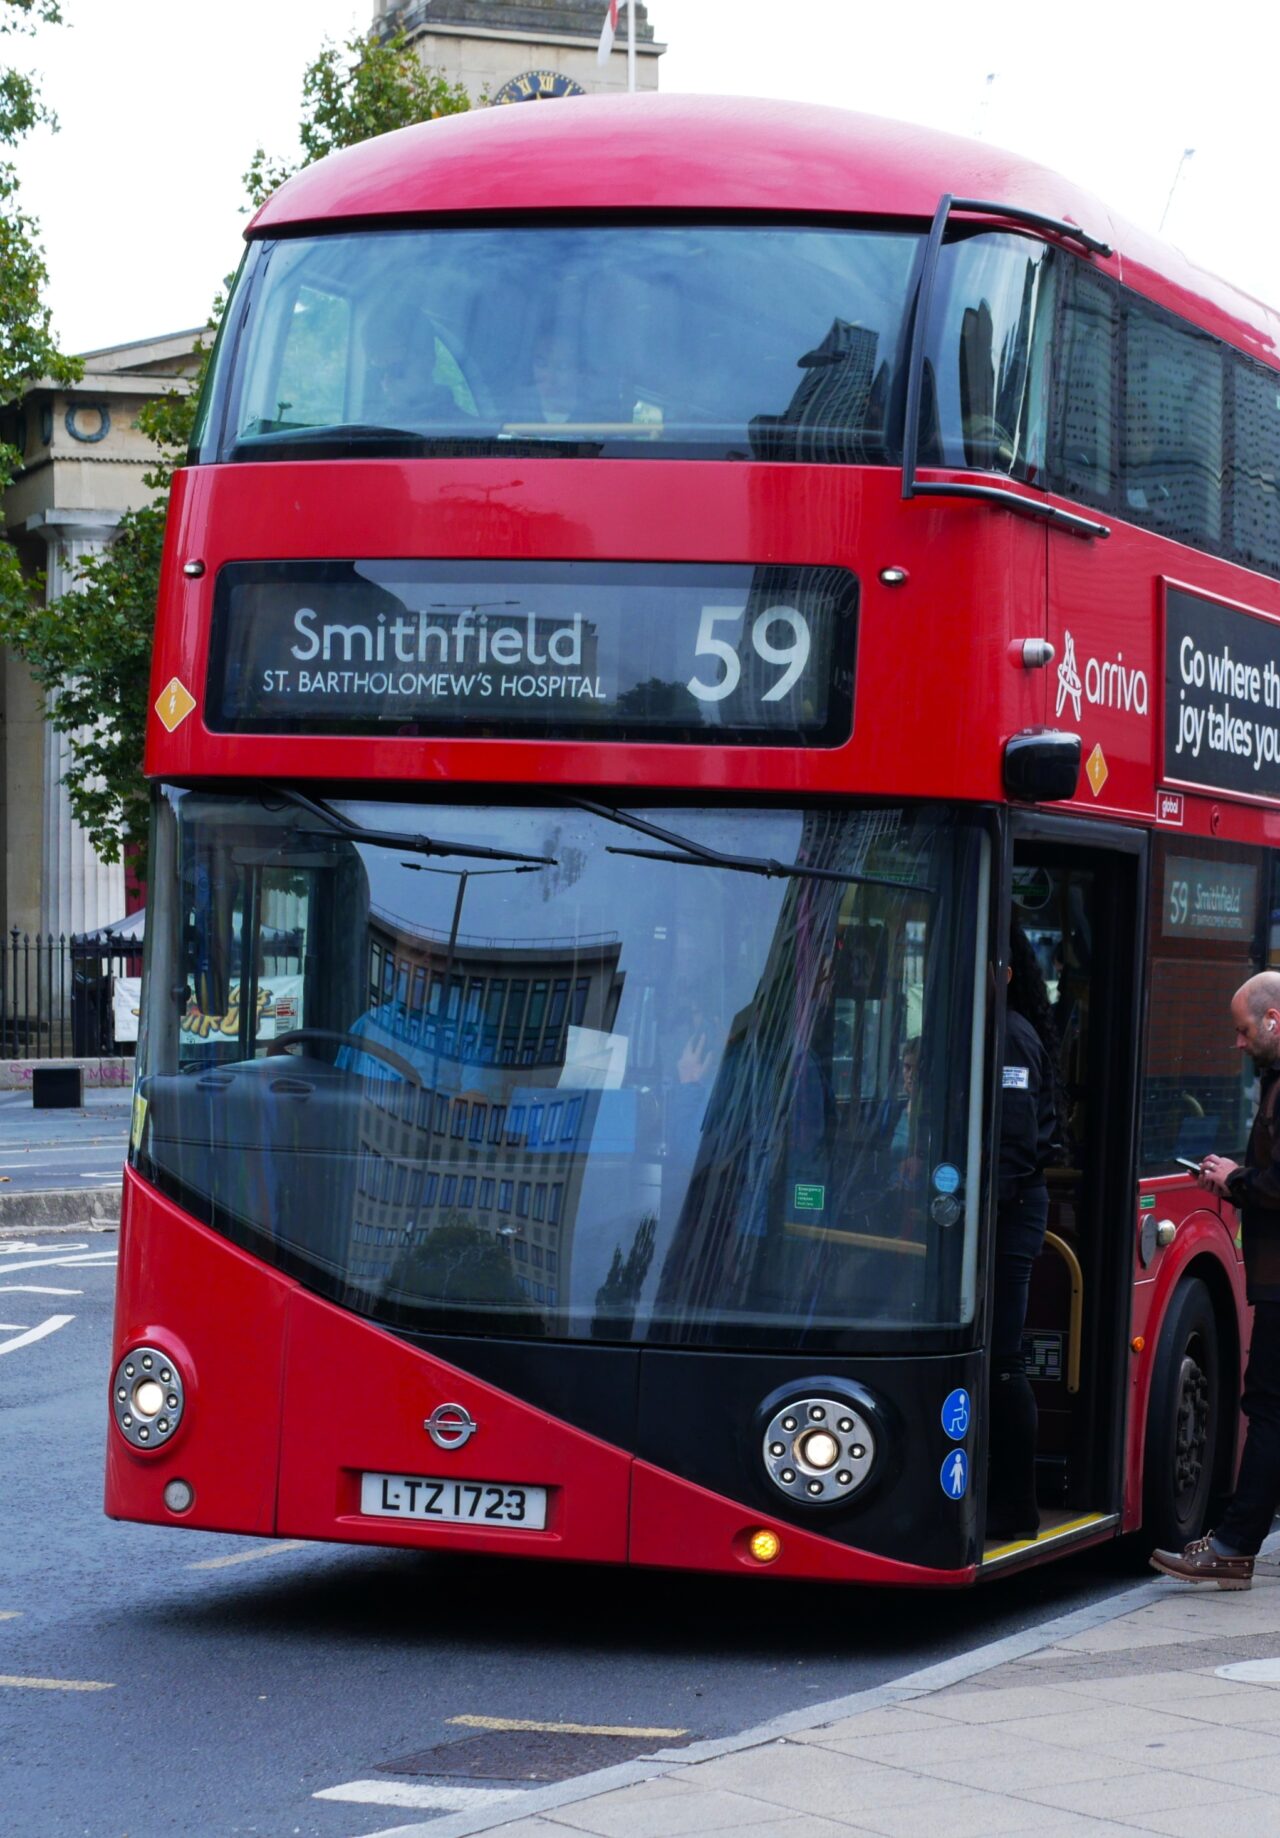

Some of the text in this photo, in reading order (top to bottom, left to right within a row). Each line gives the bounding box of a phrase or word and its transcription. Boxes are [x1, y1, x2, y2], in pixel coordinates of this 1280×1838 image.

[290, 607, 584, 667] Smithfield
[686, 605, 812, 701] 59
[262, 669, 607, 699] ST. BARTHOLOMEW'S HOSPITAL
[1085, 652, 1148, 716] arriva
[1180, 636, 1205, 687] Go
[1208, 646, 1260, 703] where
[1176, 689, 1206, 758] joy
[1208, 703, 1252, 757] takes
[1162, 798, 1178, 818] global
[1170, 881, 1188, 924] 59
[1194, 883, 1240, 913] Smithfield
[382, 1479, 526, 1521] LTZ 1723
